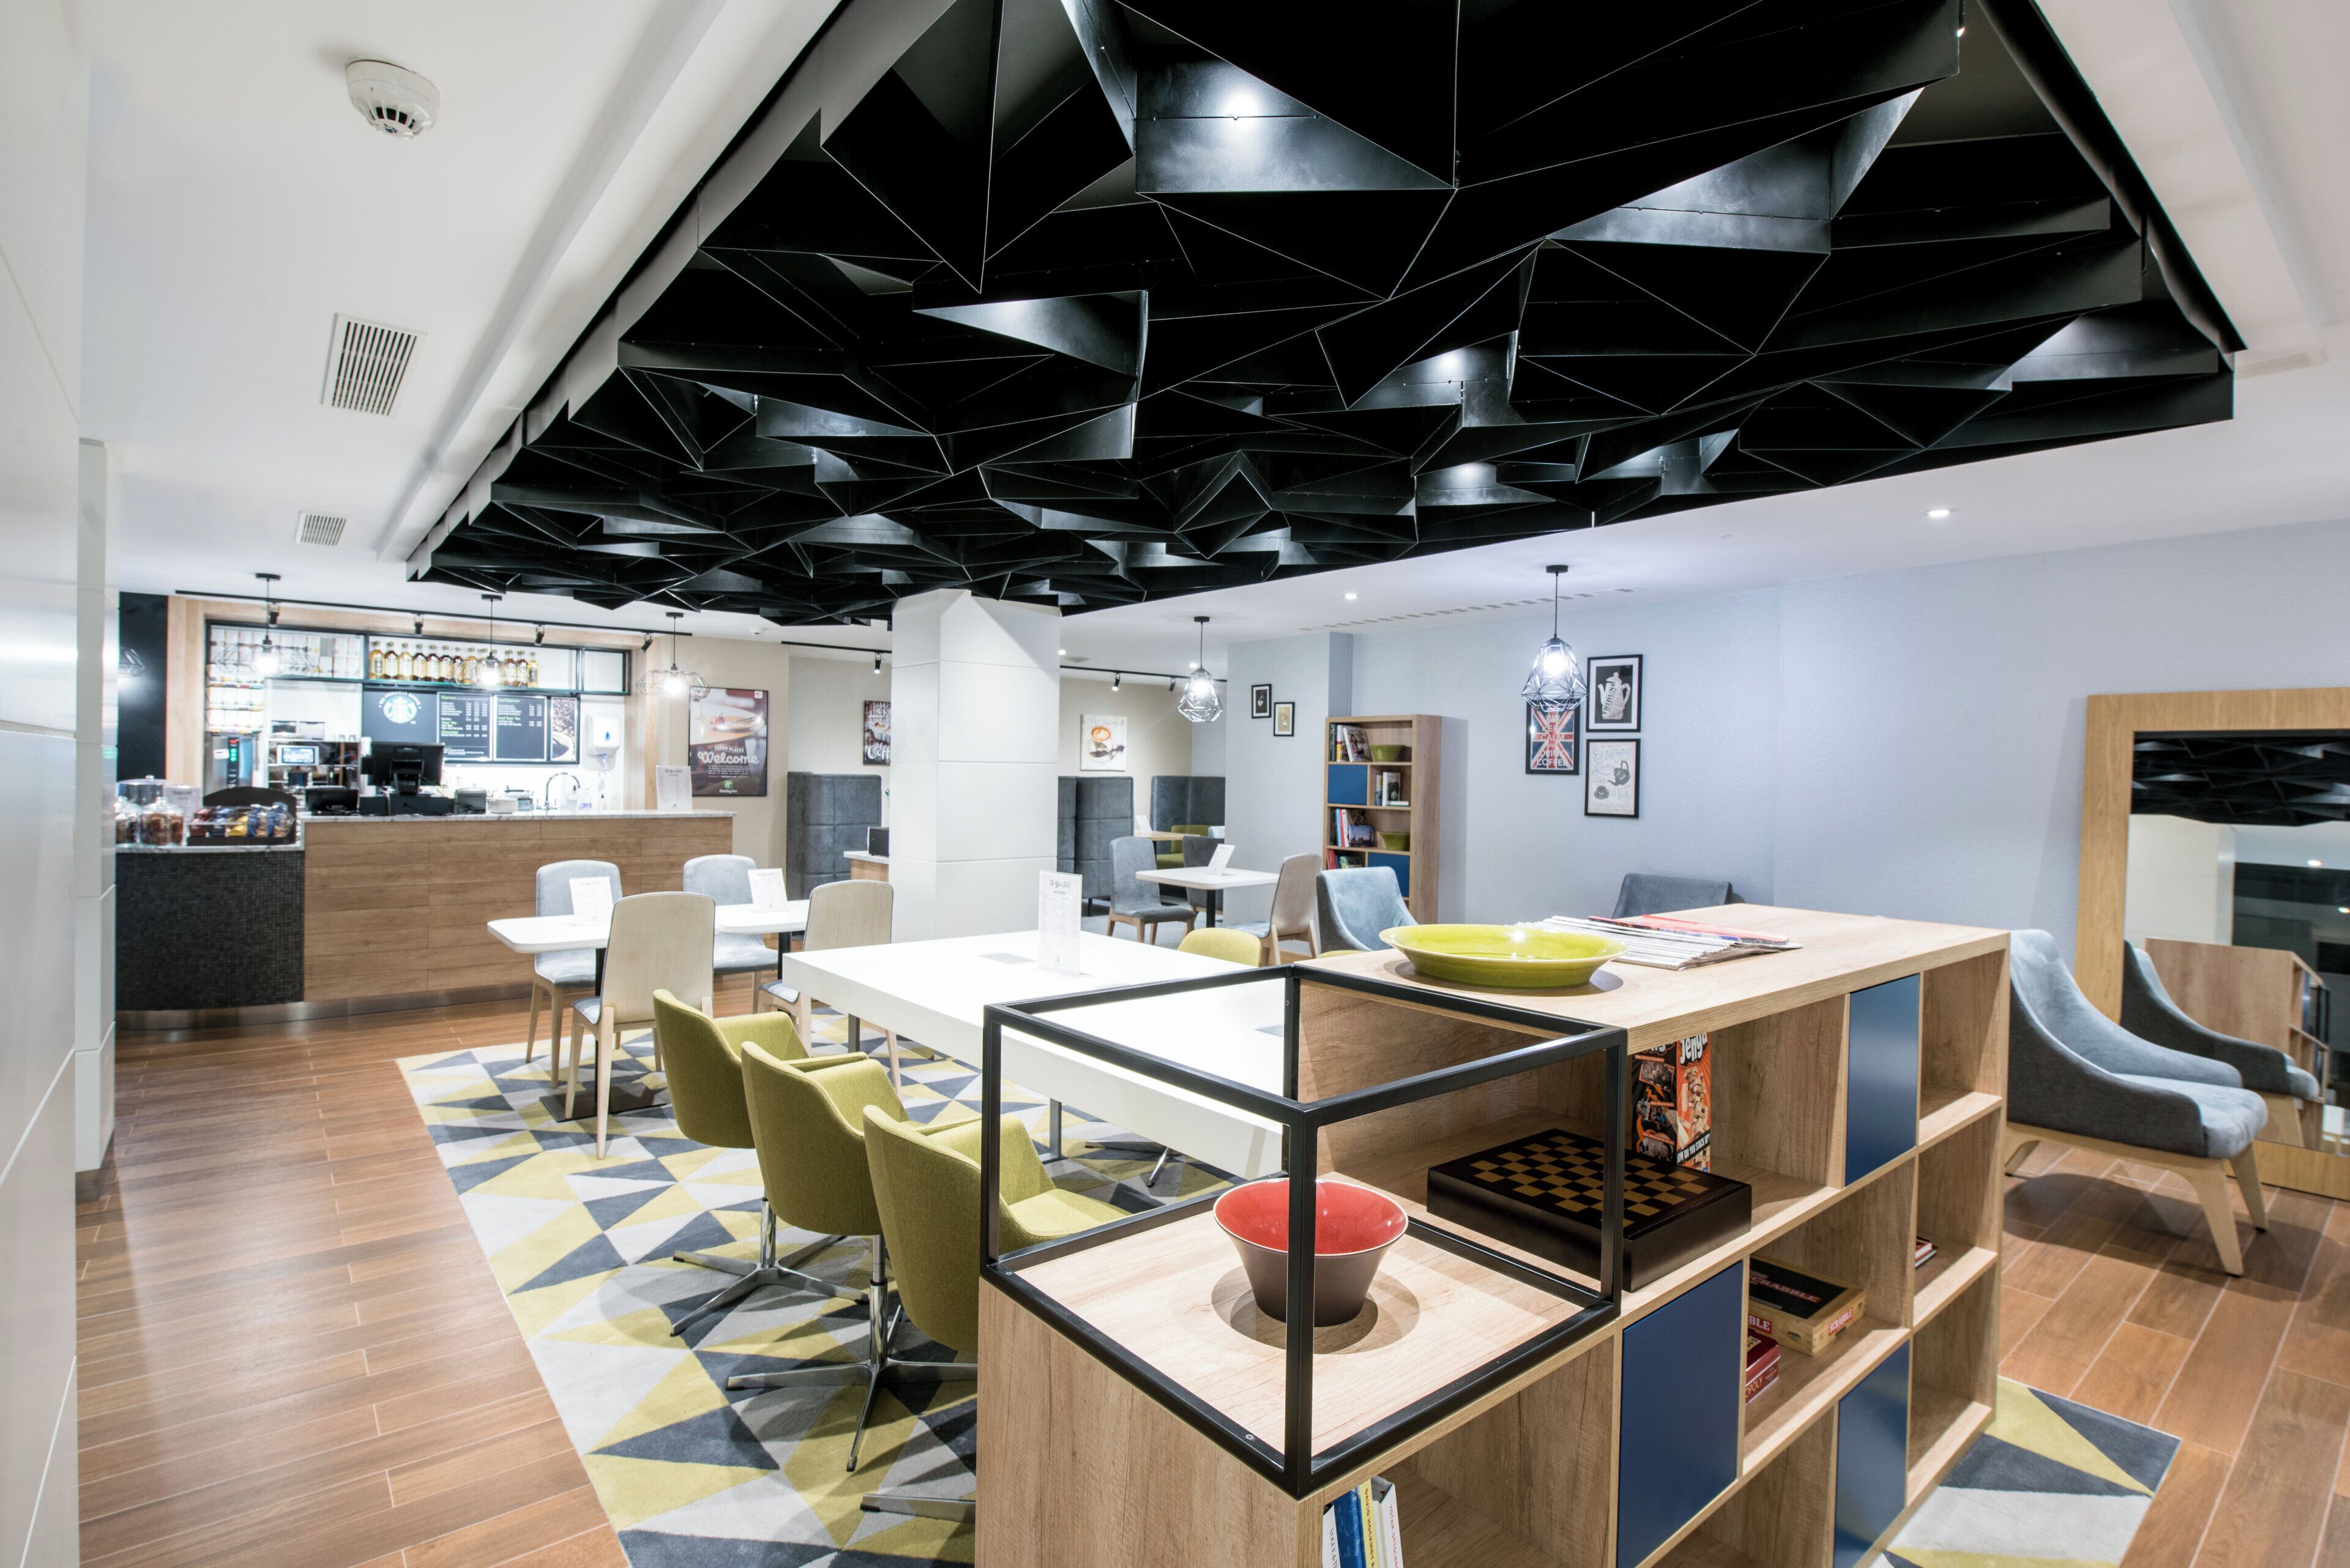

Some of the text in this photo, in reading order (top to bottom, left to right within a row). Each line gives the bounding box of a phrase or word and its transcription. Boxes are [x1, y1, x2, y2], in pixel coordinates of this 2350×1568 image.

[1603, 682, 1616, 715] TRIBUNE
[697, 751, 760, 764] Welcome
[1695, 1137, 1705, 1151] STACK
[1750, 1275, 1820, 1302] CRABBLE
[1829, 1308, 1853, 1332] SCRABBLE
[1745, 1375, 1762, 1398] OPOLY
